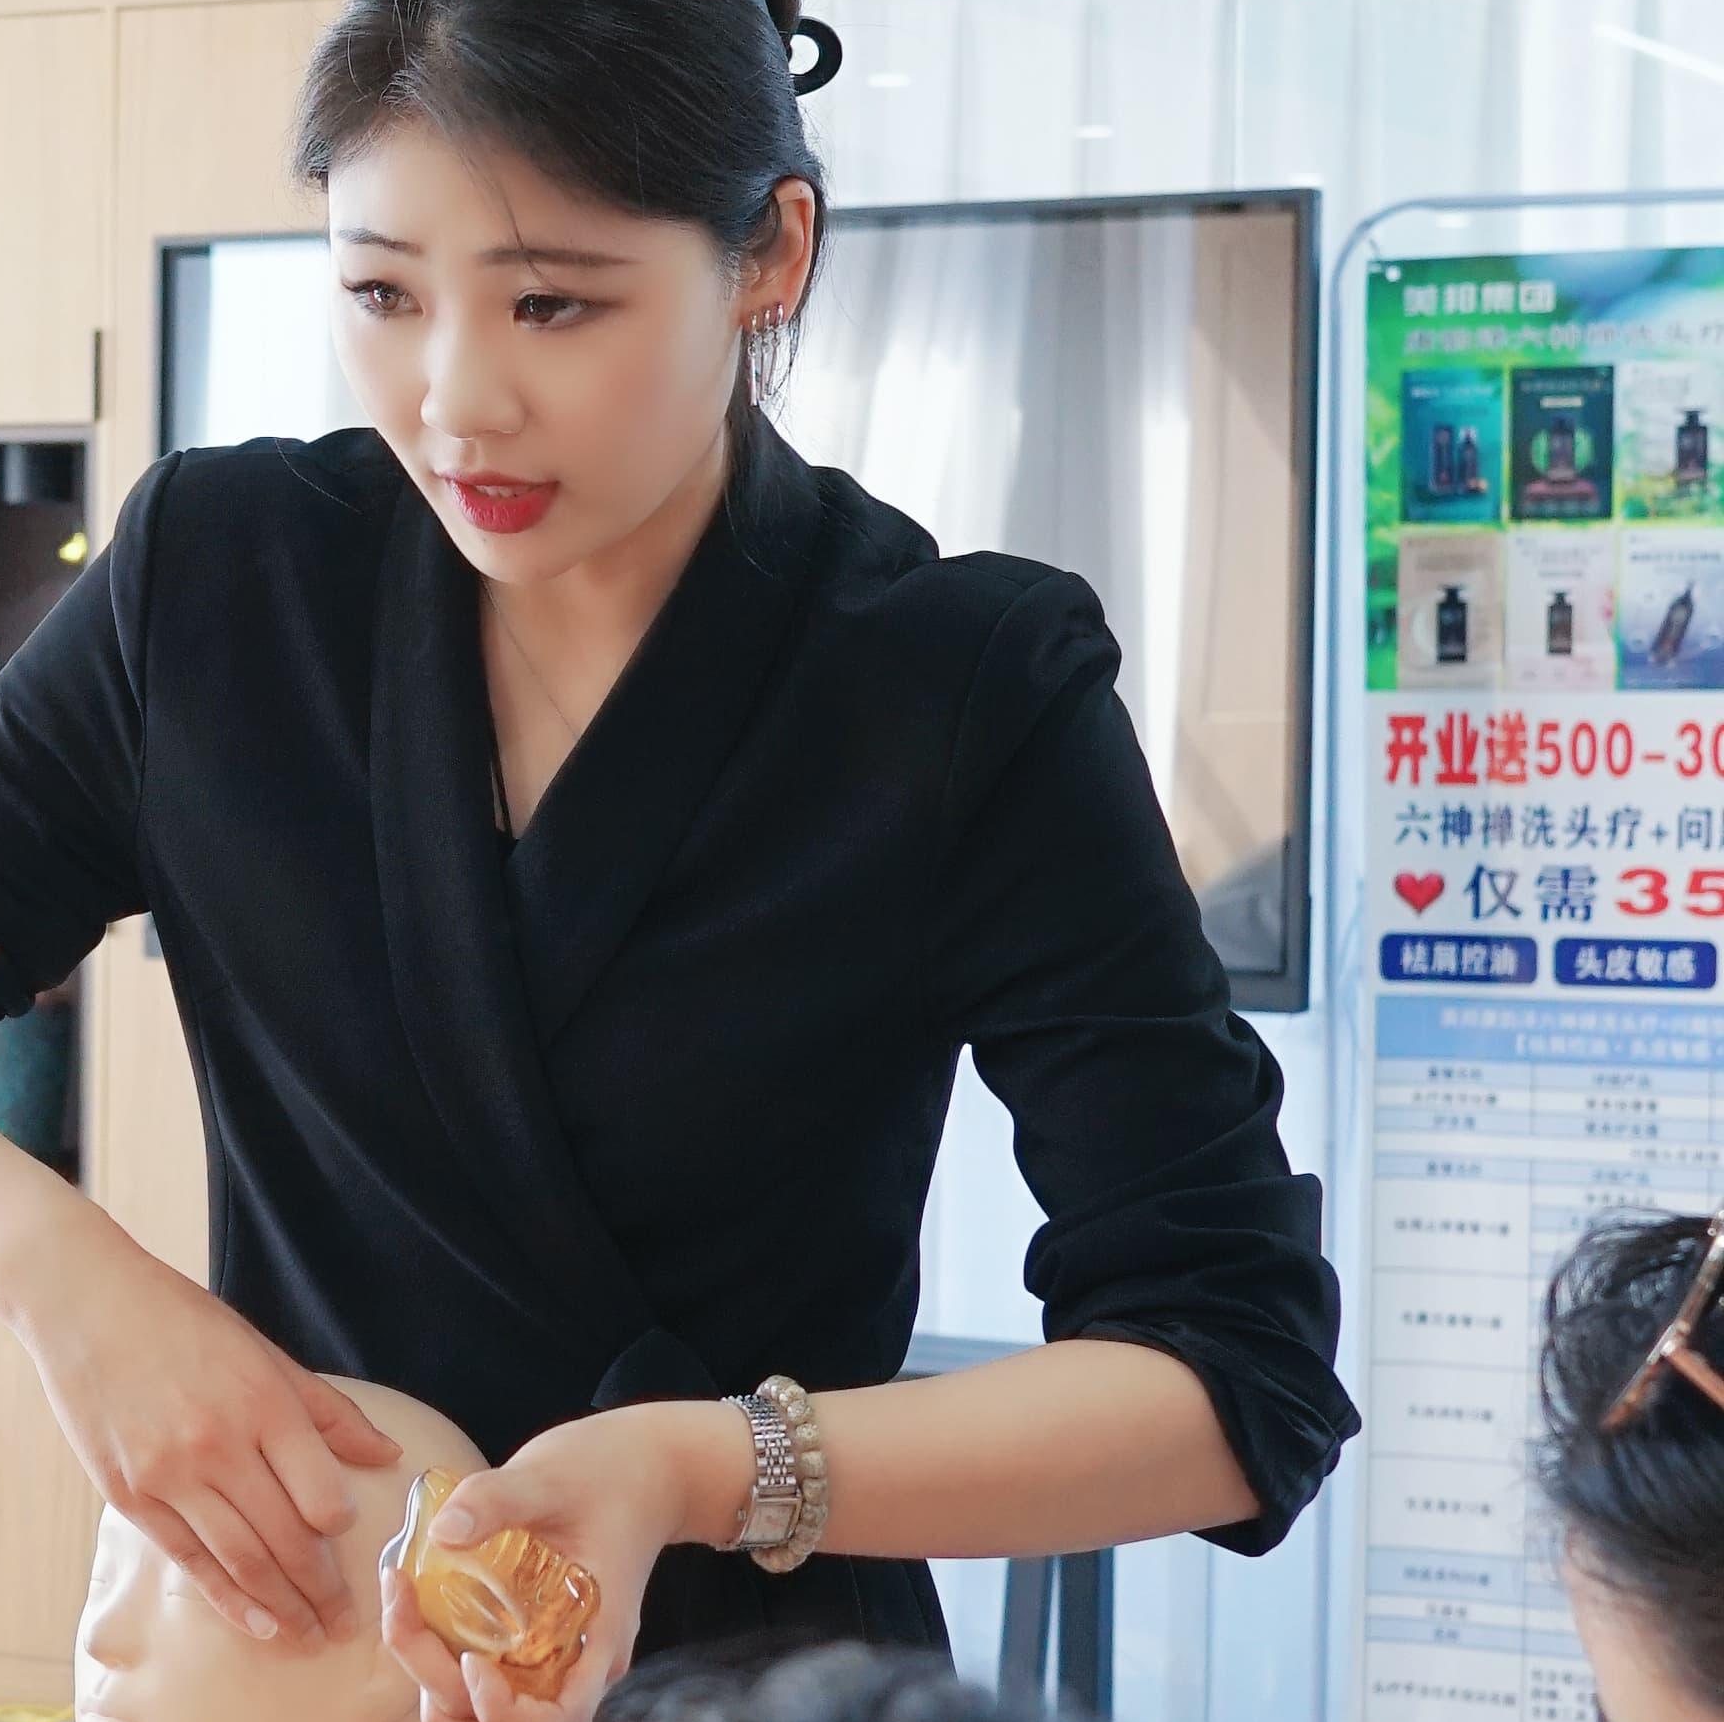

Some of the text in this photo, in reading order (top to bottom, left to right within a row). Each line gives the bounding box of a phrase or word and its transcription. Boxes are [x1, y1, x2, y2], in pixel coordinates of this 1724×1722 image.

[1394, 801, 1724, 851] 六神禅洗头疗+问
